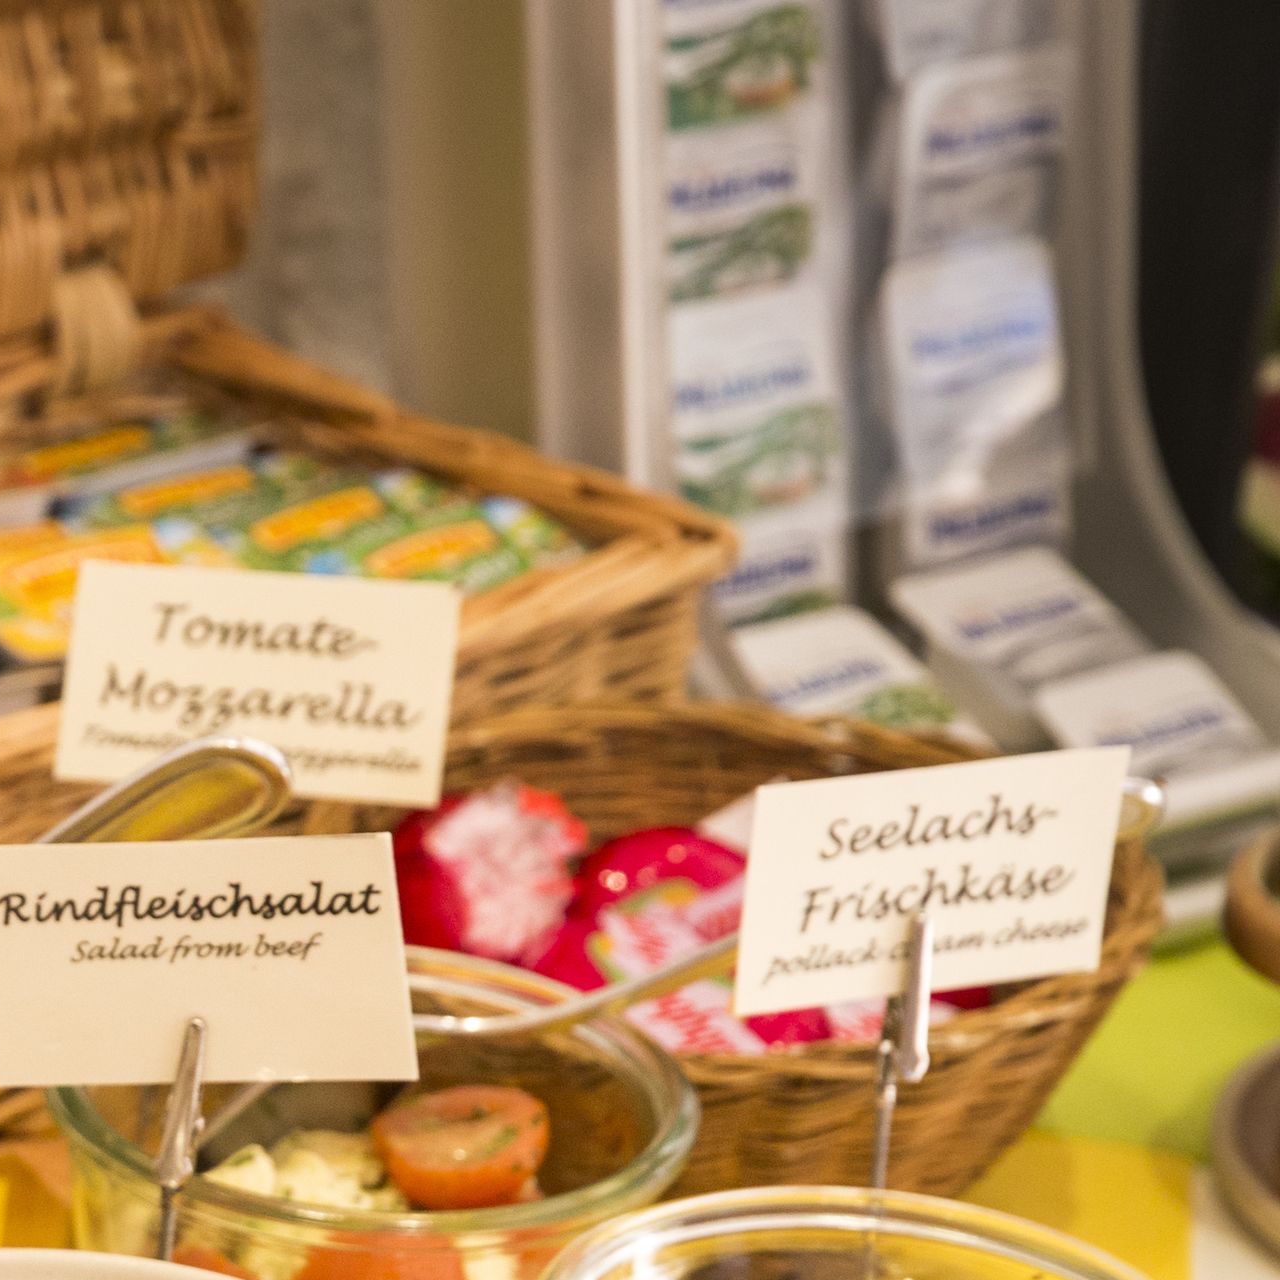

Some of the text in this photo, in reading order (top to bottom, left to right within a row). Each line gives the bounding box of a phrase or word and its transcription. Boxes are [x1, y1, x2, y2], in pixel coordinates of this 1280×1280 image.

[99, 663, 422, 729] Mozzarella
[799, 863, 1075, 934] Frischkäse
[69, 932, 324, 964] Salad from beef
